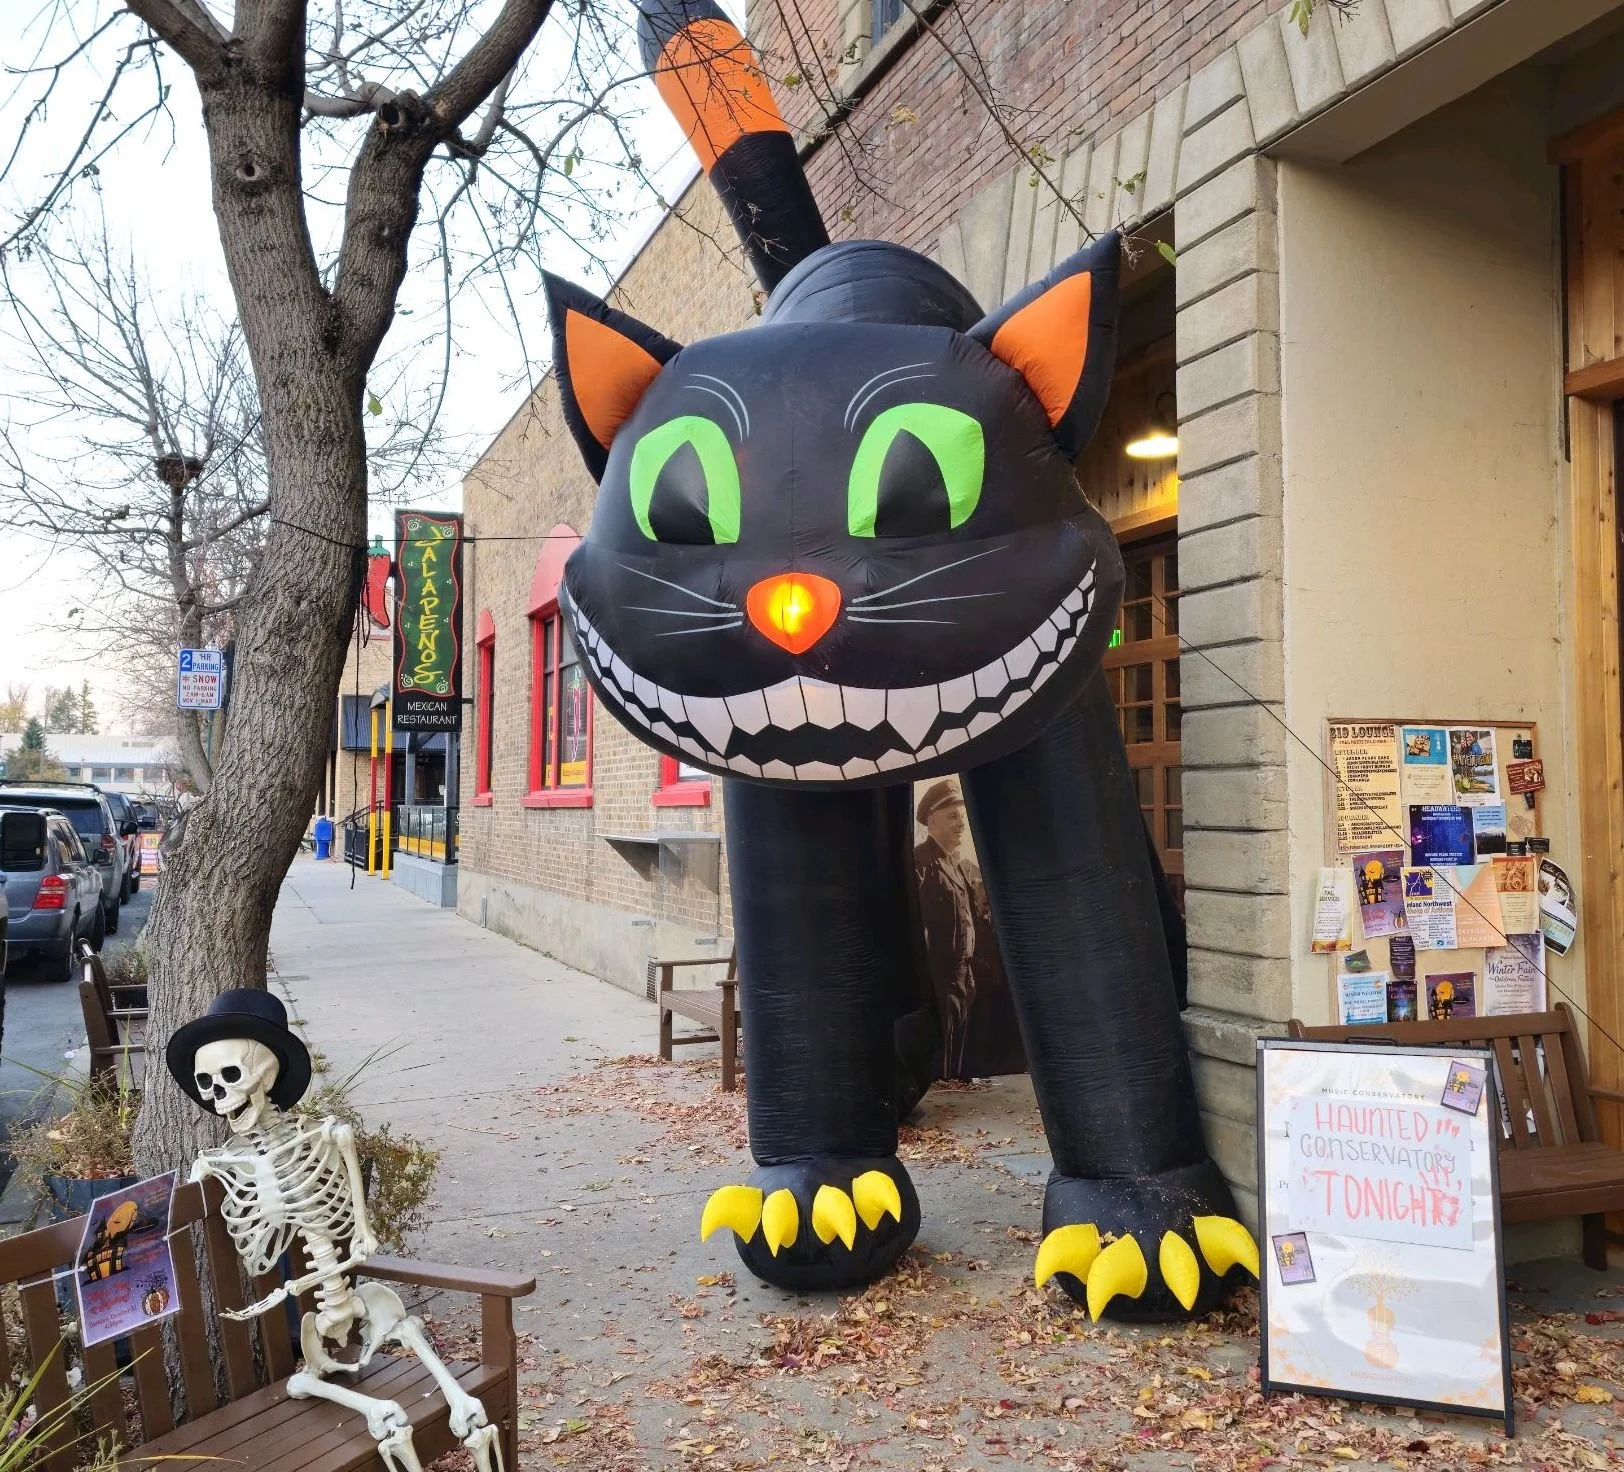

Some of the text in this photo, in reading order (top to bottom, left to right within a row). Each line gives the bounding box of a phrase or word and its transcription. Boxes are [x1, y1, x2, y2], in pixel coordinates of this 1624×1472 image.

[181, 653, 211, 668] 2 HR
[192, 662, 219, 671] PARKING
[192, 674, 217, 683] SNOW
[407, 701, 448, 712] MEXICAN
[396, 714, 458, 726] RESTAURANT
[1423, 900, 1453, 908] Northwest
[1488, 960, 1516, 975] Winter
[1321, 1088, 1427, 1101] MUSIC CONSERVATORY
[1314, 1101, 1430, 1143] HAUNTED
